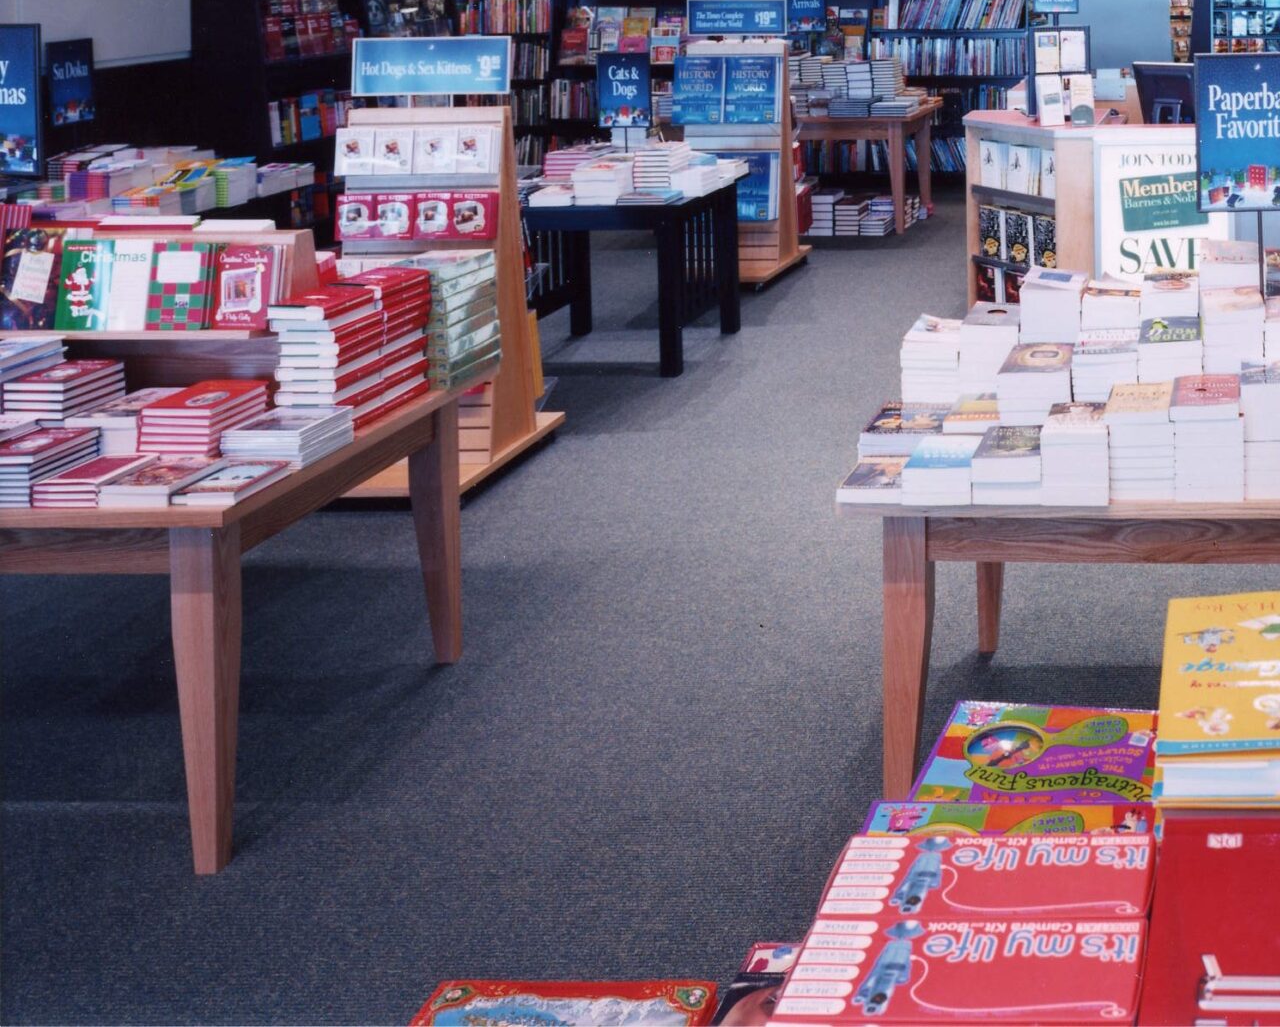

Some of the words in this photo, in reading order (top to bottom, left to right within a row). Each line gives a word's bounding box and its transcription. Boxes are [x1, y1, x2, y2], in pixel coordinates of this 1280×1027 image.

[695, 12, 707, 20] The
[721, 12, 744, 22] Complete
[53, 63, 64, 80] Su
[65, 60, 89, 79] Doku
[361, 61, 379, 76] Hot
[381, 60, 407, 79] Dogs
[407, 62, 416, 76] &
[417, 60, 435, 76] Sex
[437, 59, 472, 76] Kittens
[608, 65, 630, 81] Cats
[631, 66, 640, 80] &
[679, 70, 718, 80] HISTORY
[732, 70, 770, 80] HISTORY
[612, 82, 638, 99] Dogs
[681, 83, 714, 93] WORLD
[733, 83, 767, 93] WORLD
[1118, 153, 1164, 169] JOIN
[1124, 197, 1162, 210] Barnes
[1163, 197, 1171, 206] &
[1195, 601, 1224, 613] Rey
[969, 765, 1028, 791] Fun!
[955, 836, 995, 846] Book
[1008, 836, 1026, 846] Kit
[1028, 836, 1089, 846] Camera
[953, 844, 1017, 871] life
[1026, 845, 1088, 870] my
[1098, 846, 1149, 870] it's
[822, 923, 859, 931] BOOK
[927, 922, 969, 933] Book
[984, 922, 1003, 933] Kit
[1004, 922, 1073, 934] Camera
[923, 932, 997, 963] life
[1003, 934, 1074, 960] my
[1082, 934, 1138, 962] it's
